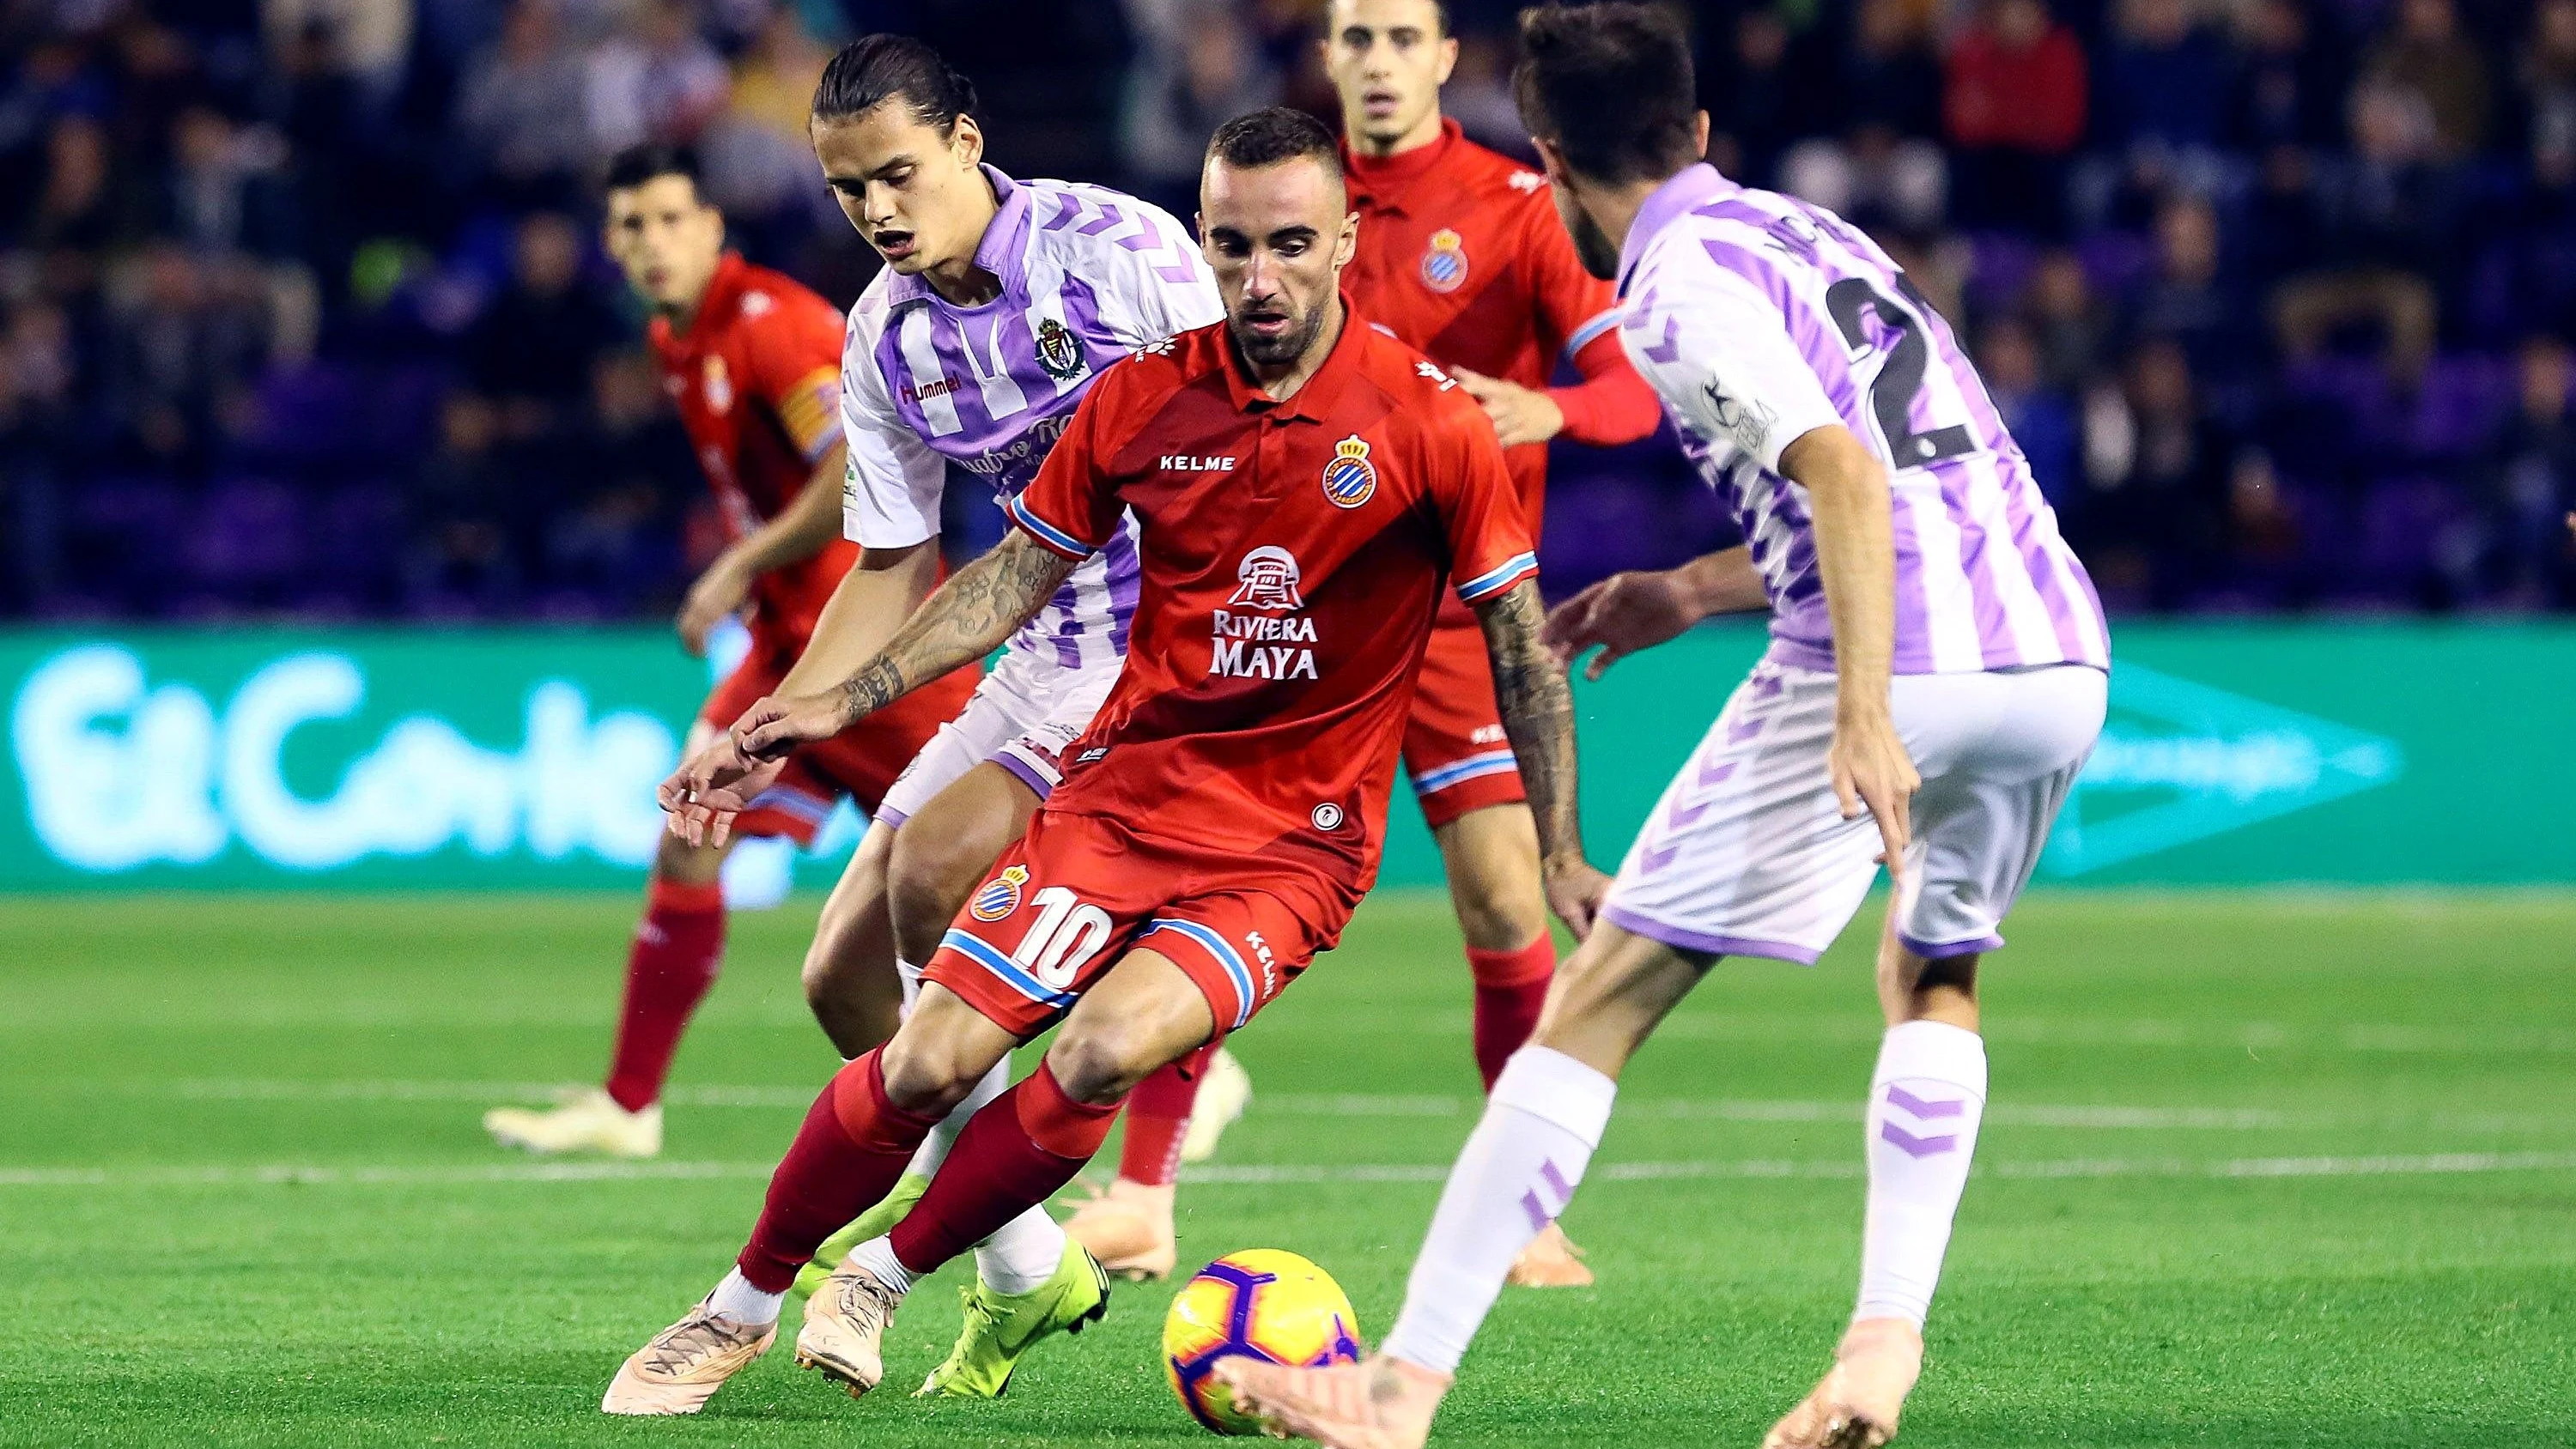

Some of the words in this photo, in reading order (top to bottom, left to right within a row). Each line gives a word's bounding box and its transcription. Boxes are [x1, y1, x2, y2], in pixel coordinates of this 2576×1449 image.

[900, 371, 962, 405] hummel
[1160, 455, 1236, 471] KELME
[1212, 609, 1318, 643] RIVIERA
[1209, 638, 1318, 680] MAYA
[12, 644, 223, 870] El
[1012, 886, 1114, 988] 10
